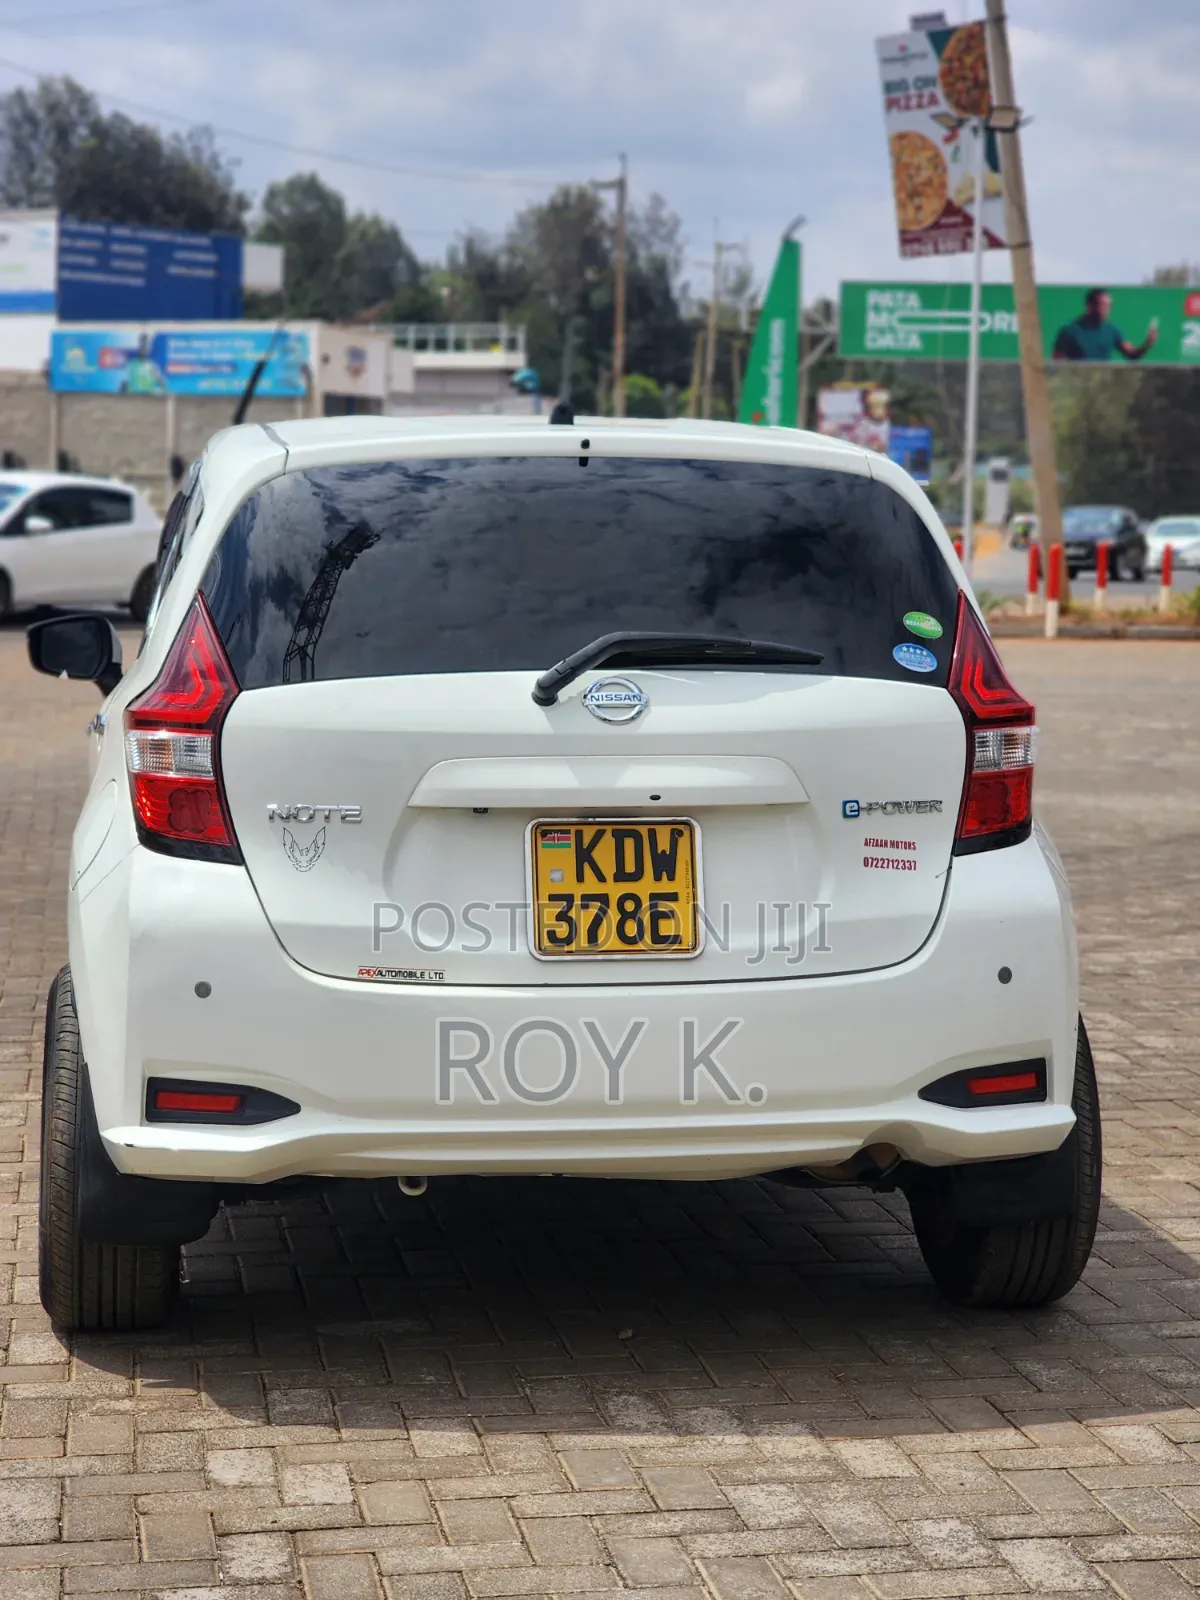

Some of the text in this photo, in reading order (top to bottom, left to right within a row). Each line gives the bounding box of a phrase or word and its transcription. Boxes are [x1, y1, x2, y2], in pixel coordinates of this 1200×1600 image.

[886, 92, 940, 113] PIZZA
[590, 694, 642, 702] NISSAN
[267, 804, 362, 823] NOTE
[863, 837, 917, 851] AFZAAN MOTORS
[574, 828, 684, 883] KDW
[863, 856, 917, 871] 0722712337
[546, 892, 682, 946] 378E
